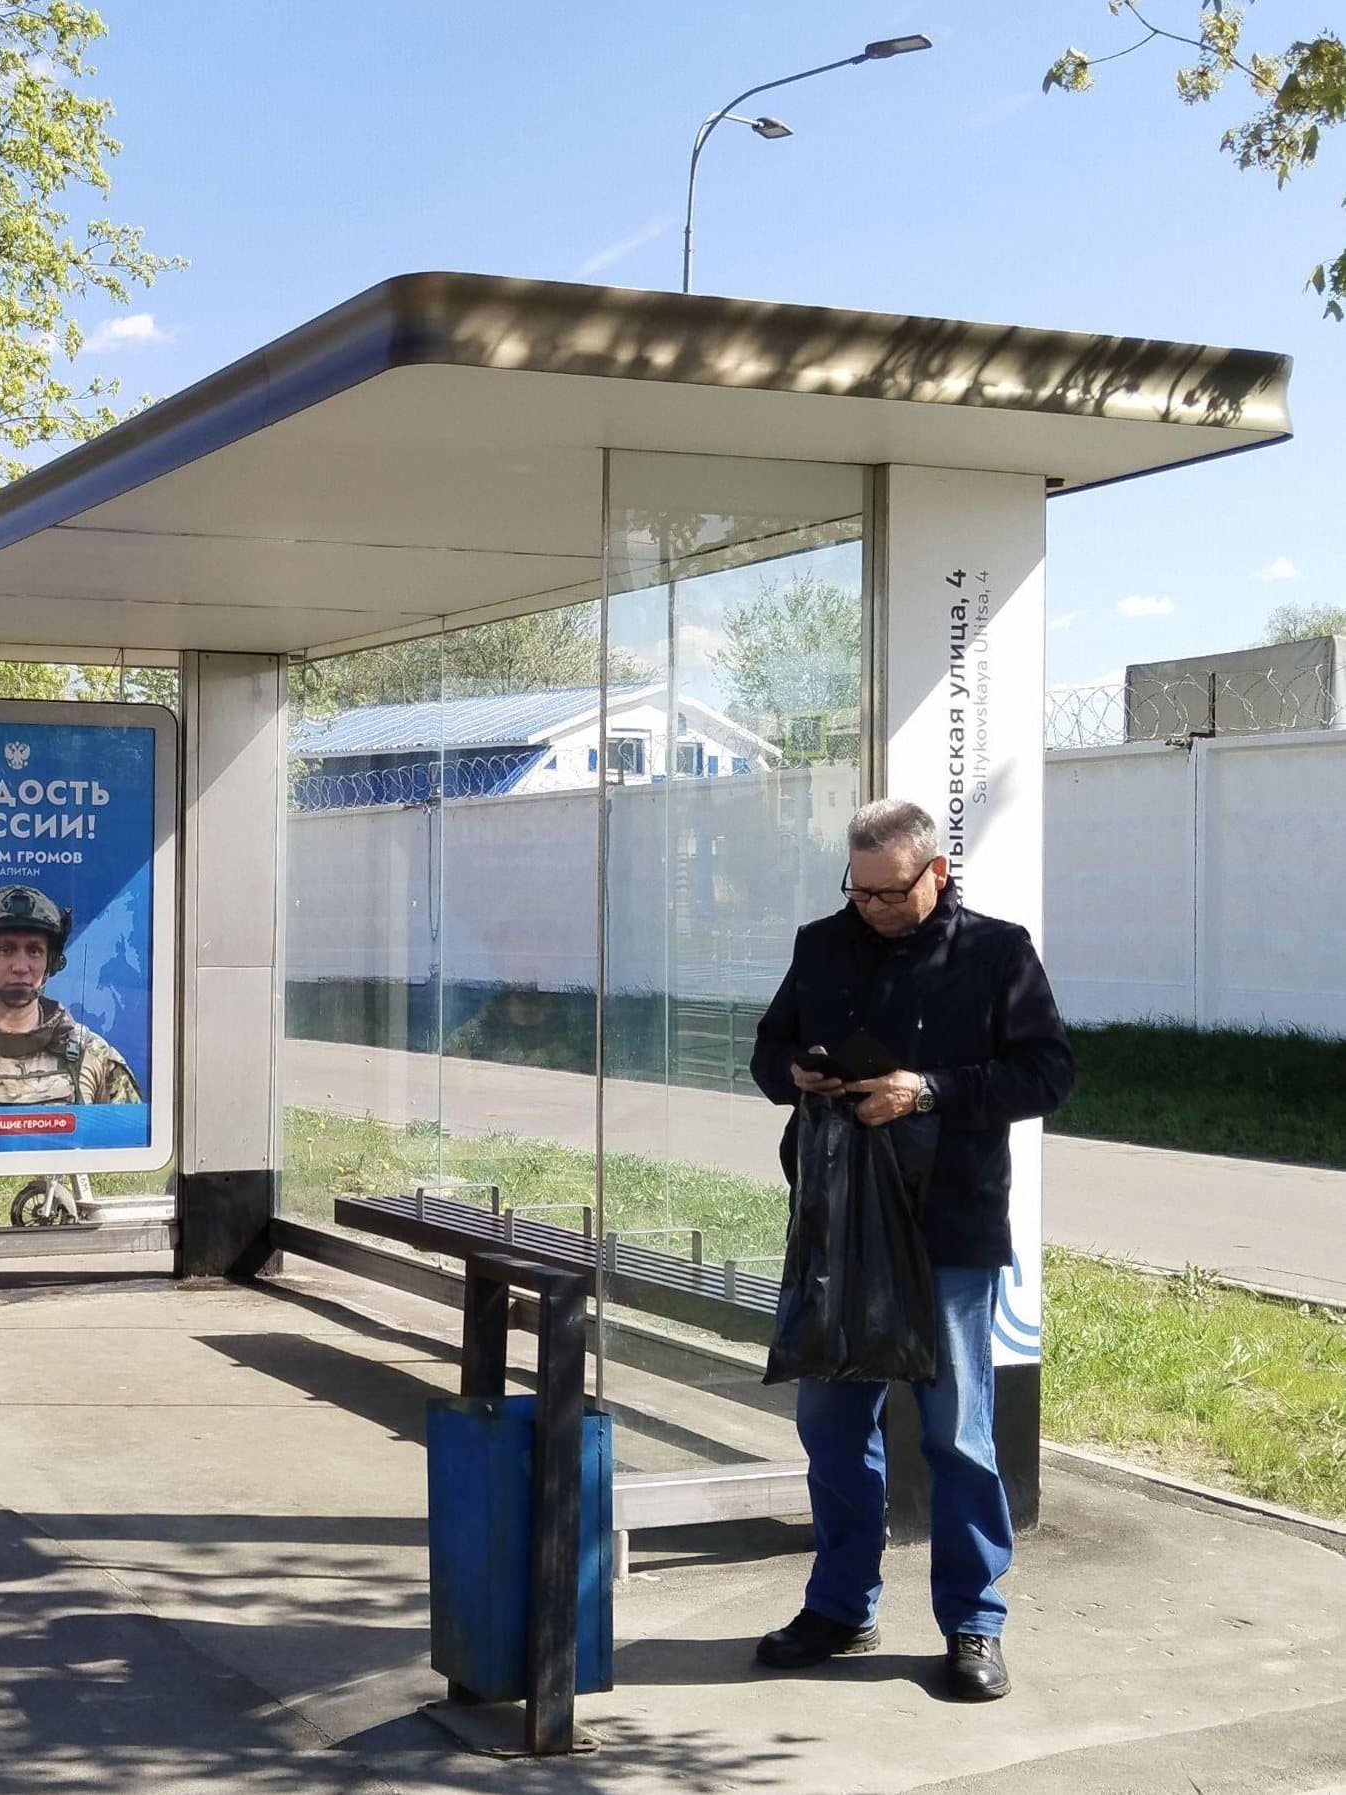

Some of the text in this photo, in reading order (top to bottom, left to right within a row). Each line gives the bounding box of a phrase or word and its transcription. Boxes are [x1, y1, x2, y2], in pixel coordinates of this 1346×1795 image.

[946, 569, 966, 588] 4
[950, 598, 970, 698] улица,
[972, 570, 991, 803] Saltykovskaya Ulitsa, 4
[17, 850, 83, 864] ГРОМОВ
